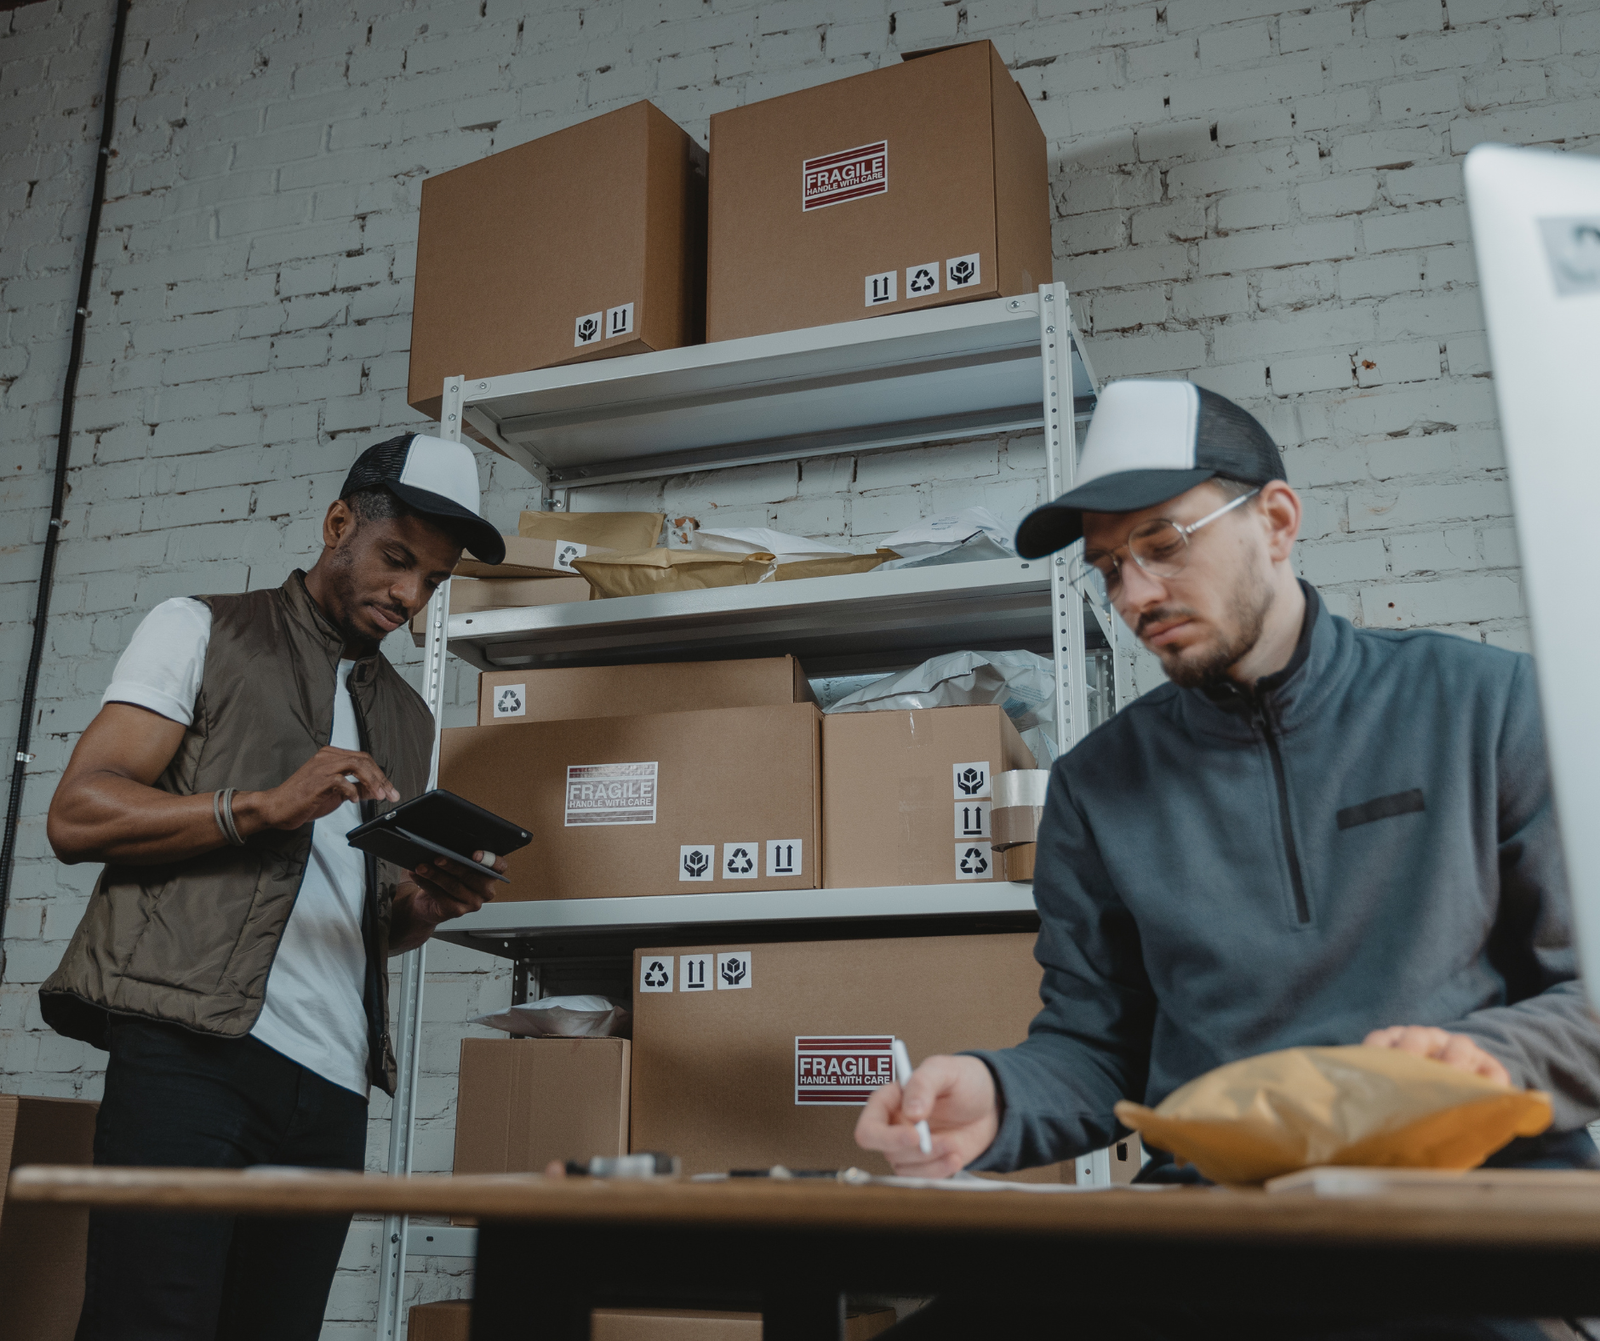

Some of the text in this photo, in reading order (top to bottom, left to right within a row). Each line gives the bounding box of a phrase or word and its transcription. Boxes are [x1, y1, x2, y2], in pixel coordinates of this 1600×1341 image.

[807, 158, 883, 189] FRAGILE
[807, 171, 883, 195] HANDLE WITH CARE
[569, 781, 652, 800] FRAGILE
[569, 798, 652, 808] HANDLE WITH CARE
[800, 1057, 890, 1075] FRAGILE
[800, 1076, 890, 1084] HANDLE WITH CARE
